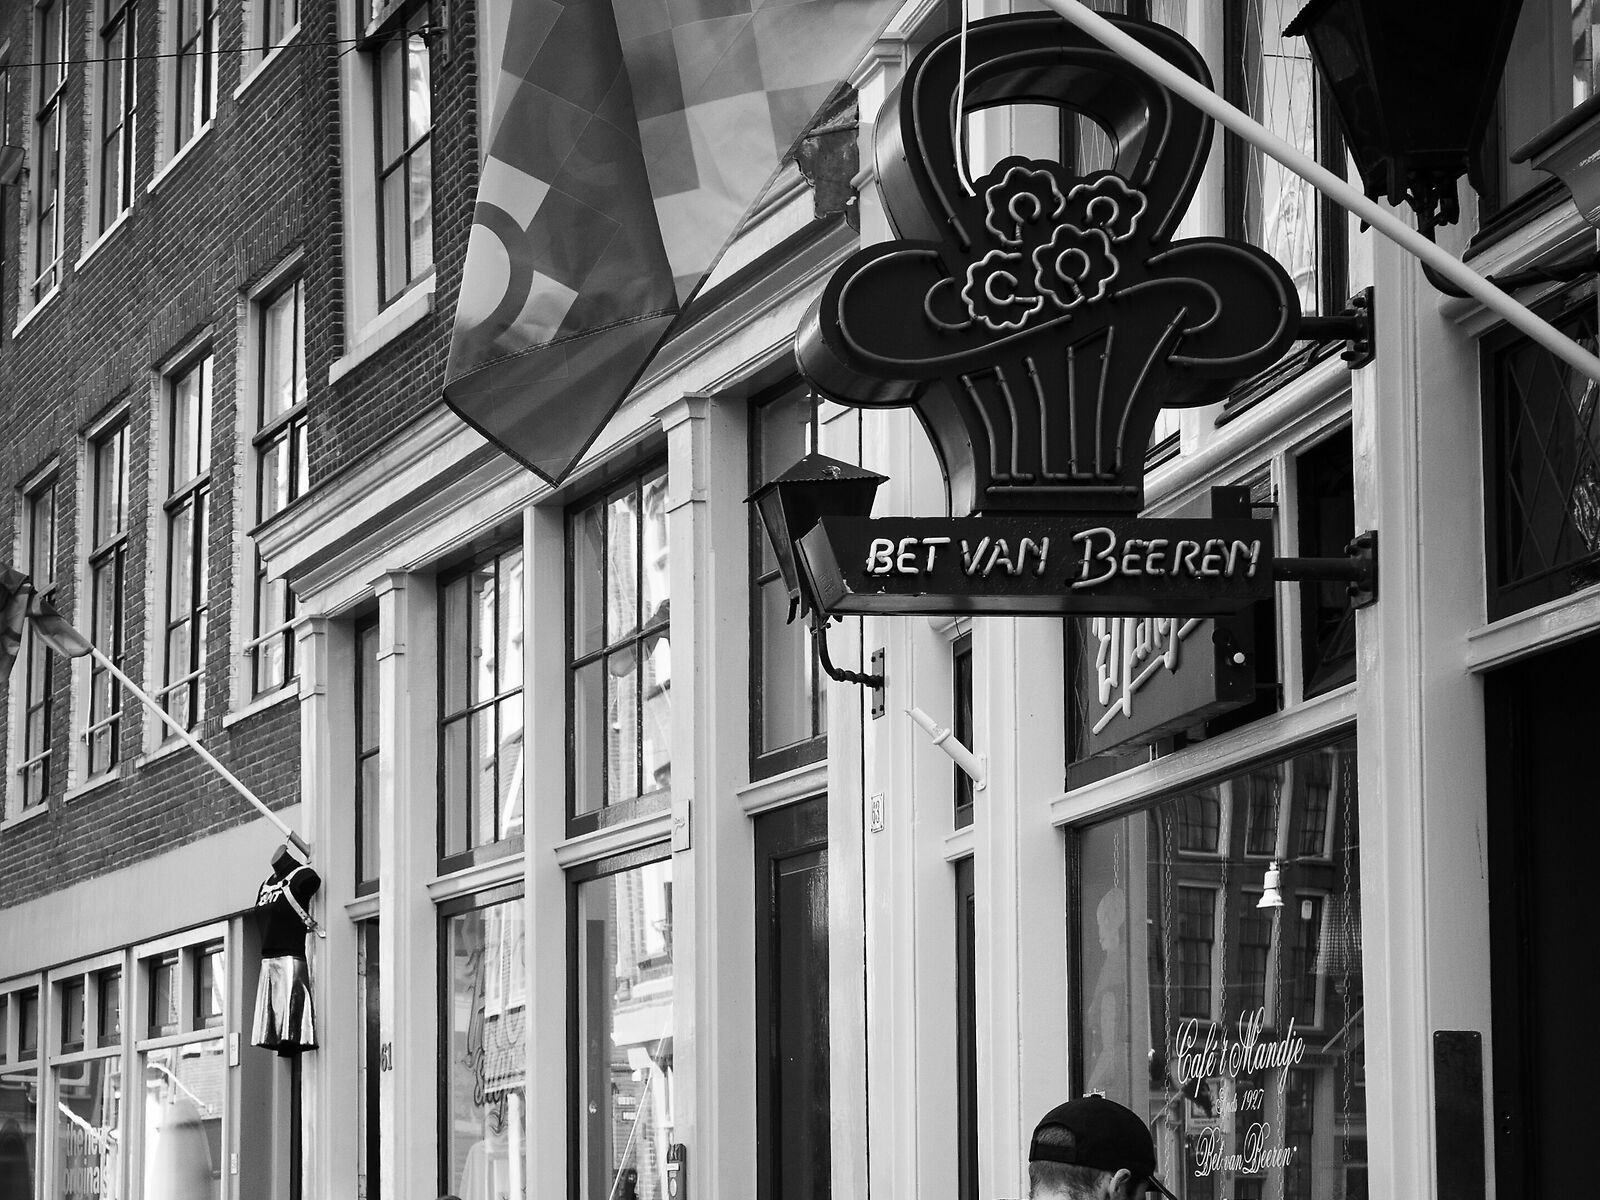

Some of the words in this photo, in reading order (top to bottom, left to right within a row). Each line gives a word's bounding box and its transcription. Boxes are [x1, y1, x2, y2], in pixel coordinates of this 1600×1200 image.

[866, 536, 951, 574] BET
[960, 536, 1051, 576] VAN
[1070, 526, 1262, 590] BEEREN
[381, 1041, 393, 1073] 61
[1175, 1017, 1218, 1099] Café
[1229, 1005, 1306, 1095] Mandje
[1240, 1088, 1265, 1111] 1927
[1194, 1126, 1226, 1178] Bet
[1242, 1122, 1293, 1175] Beeren
